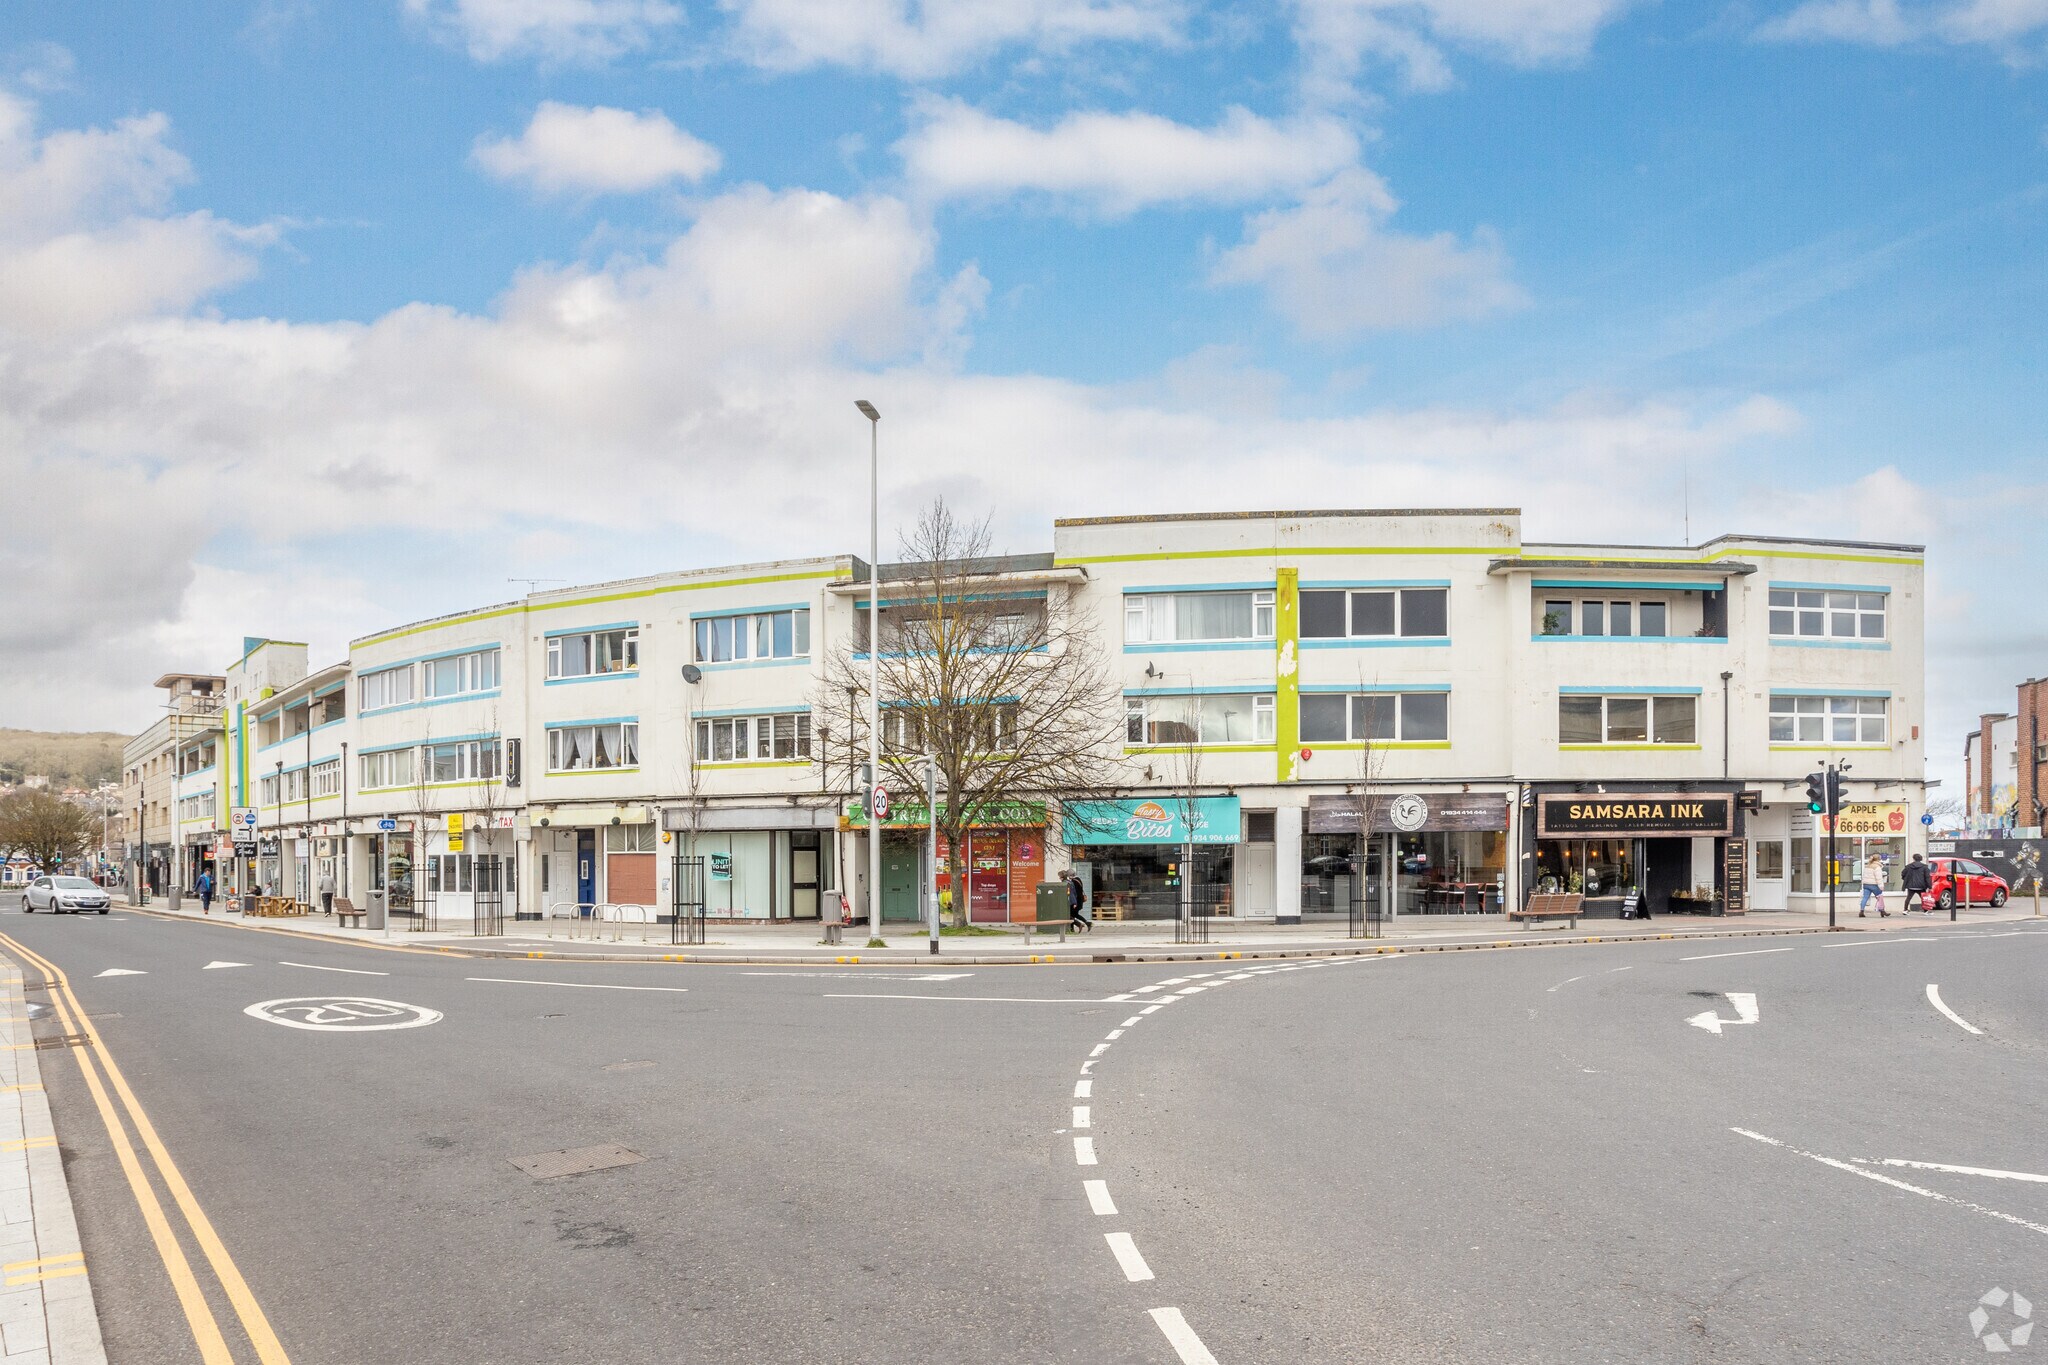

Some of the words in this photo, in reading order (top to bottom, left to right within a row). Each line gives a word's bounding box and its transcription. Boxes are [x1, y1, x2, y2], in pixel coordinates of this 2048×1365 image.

[875, 795, 886, 809] 20
[992, 808, 1031, 820] OOD
[1137, 806, 1162, 819] Tasty
[1569, 804, 1665, 819] SAMSARA
[1670, 804, 1704, 819] INK
[1850, 805, 1877, 814] APPLE
[498, 817, 513, 828] TAX
[1127, 817, 1173, 840] Bites
[273, 1001, 405, 1024] 20
